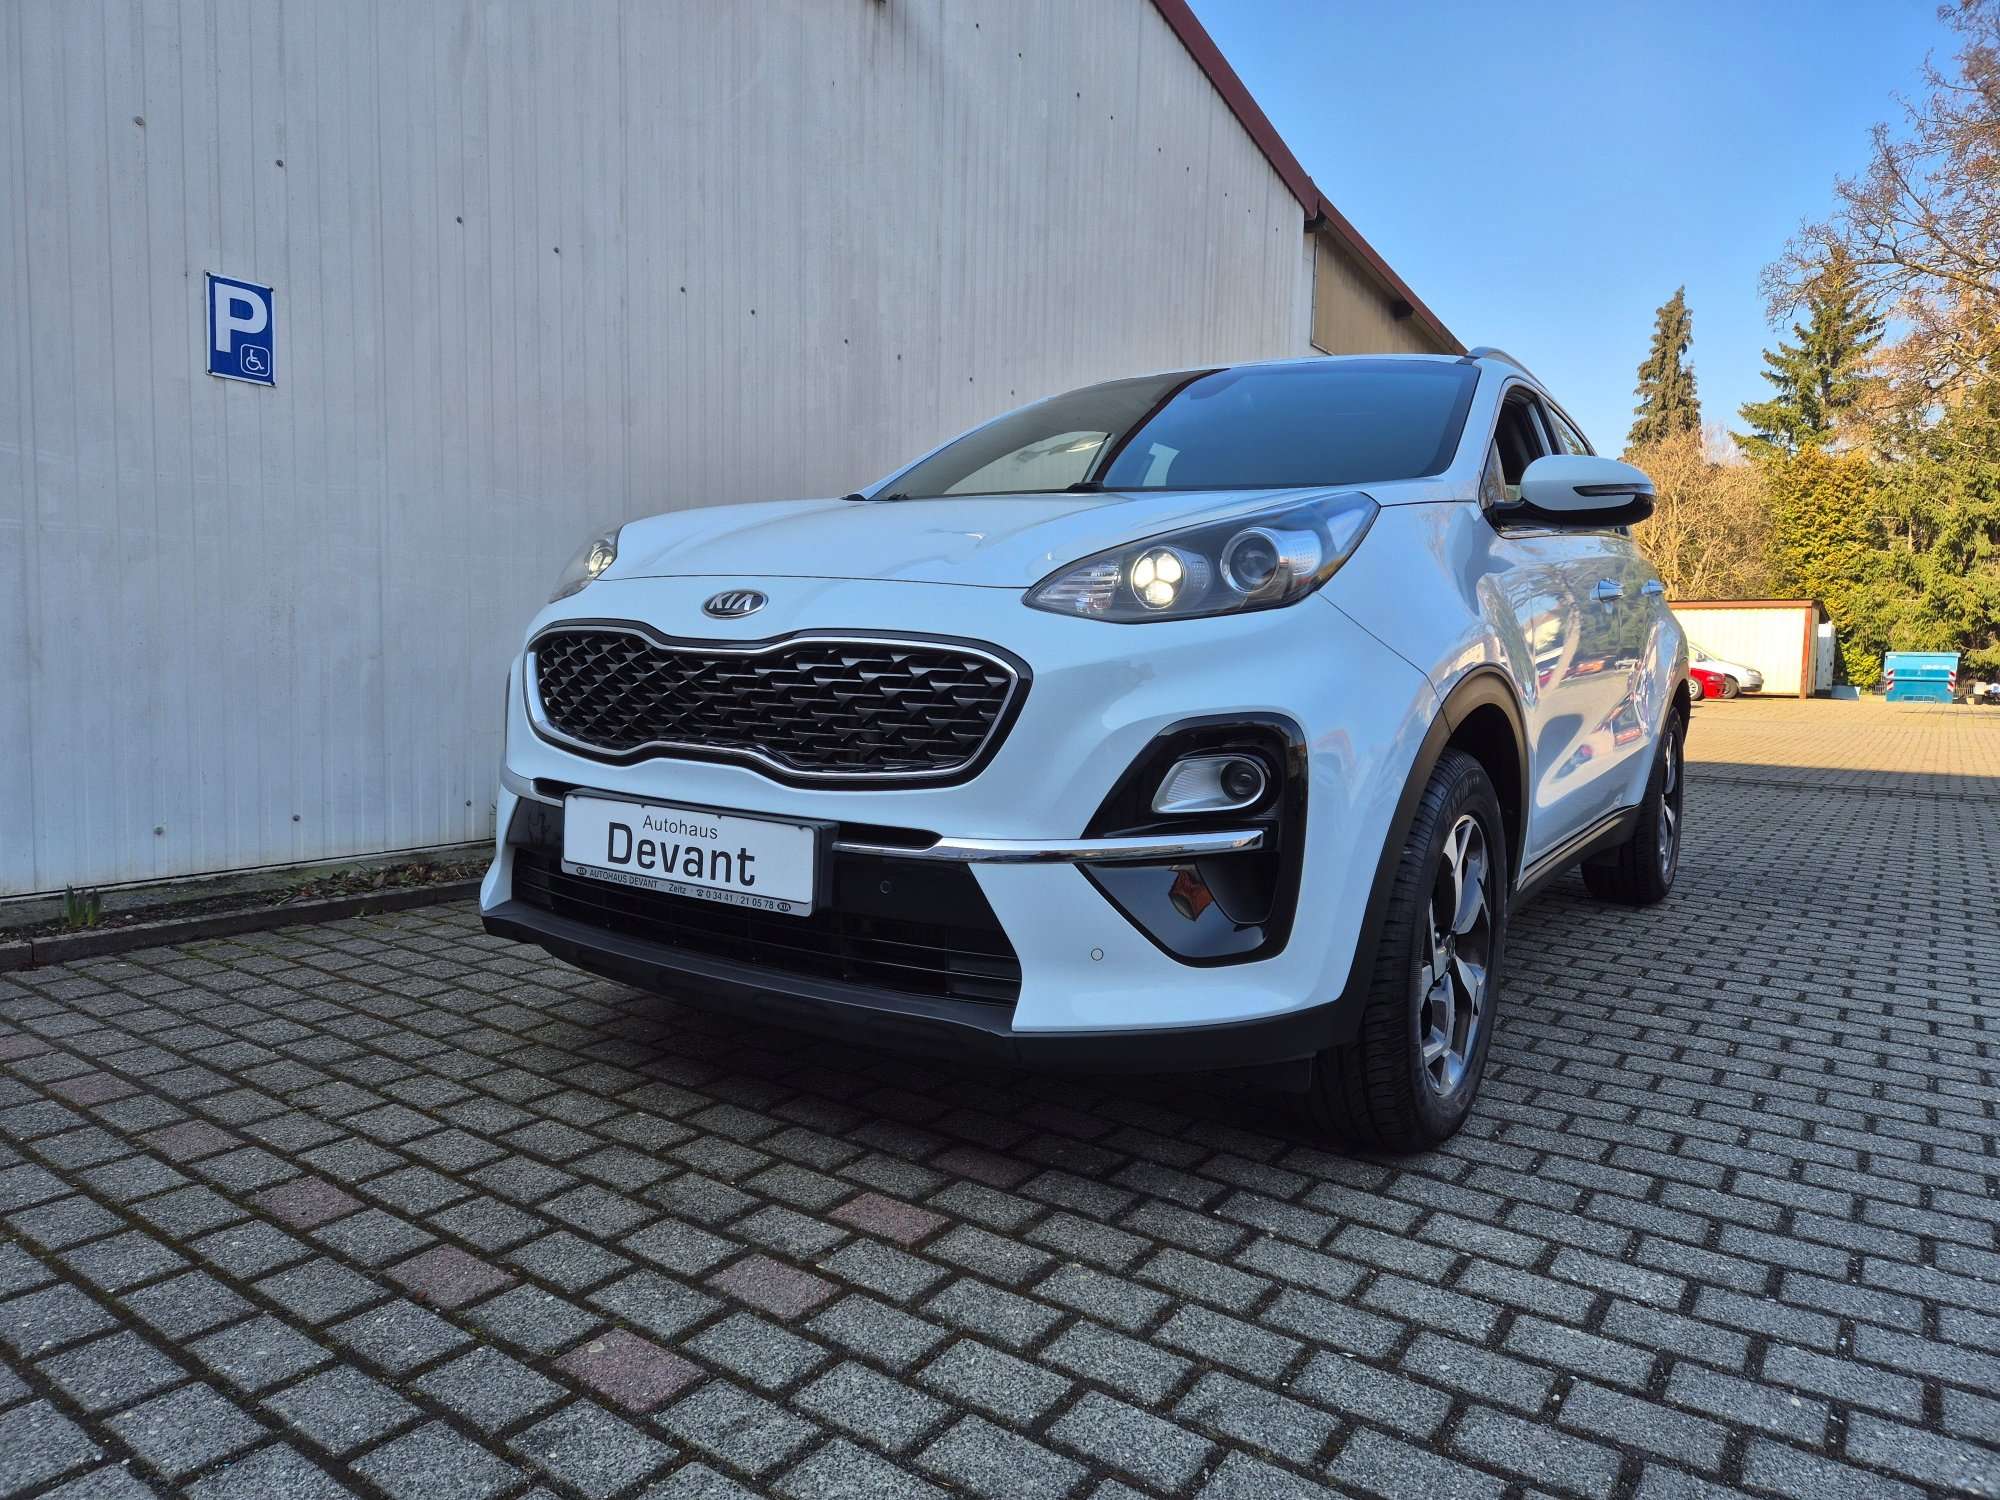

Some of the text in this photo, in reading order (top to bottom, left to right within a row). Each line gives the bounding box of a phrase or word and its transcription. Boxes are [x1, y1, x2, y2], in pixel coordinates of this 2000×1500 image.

[214, 282, 268, 353] P
[708, 593, 755, 610] KIA
[642, 815, 719, 840] Autohaus
[607, 821, 756, 887] Devant
[589, 869, 628, 884] AUTOHAUS
[628, 876, 658, 889] DEVANT
[668, 883, 687, 895] Zeitz
[705, 890, 711, 899] 0
[713, 891, 722, 901] 34
[723, 893, 733, 902] 41
[740, 895, 750, 905] 21
[752, 897, 763, 908] 05
[764, 899, 774, 910] 78
